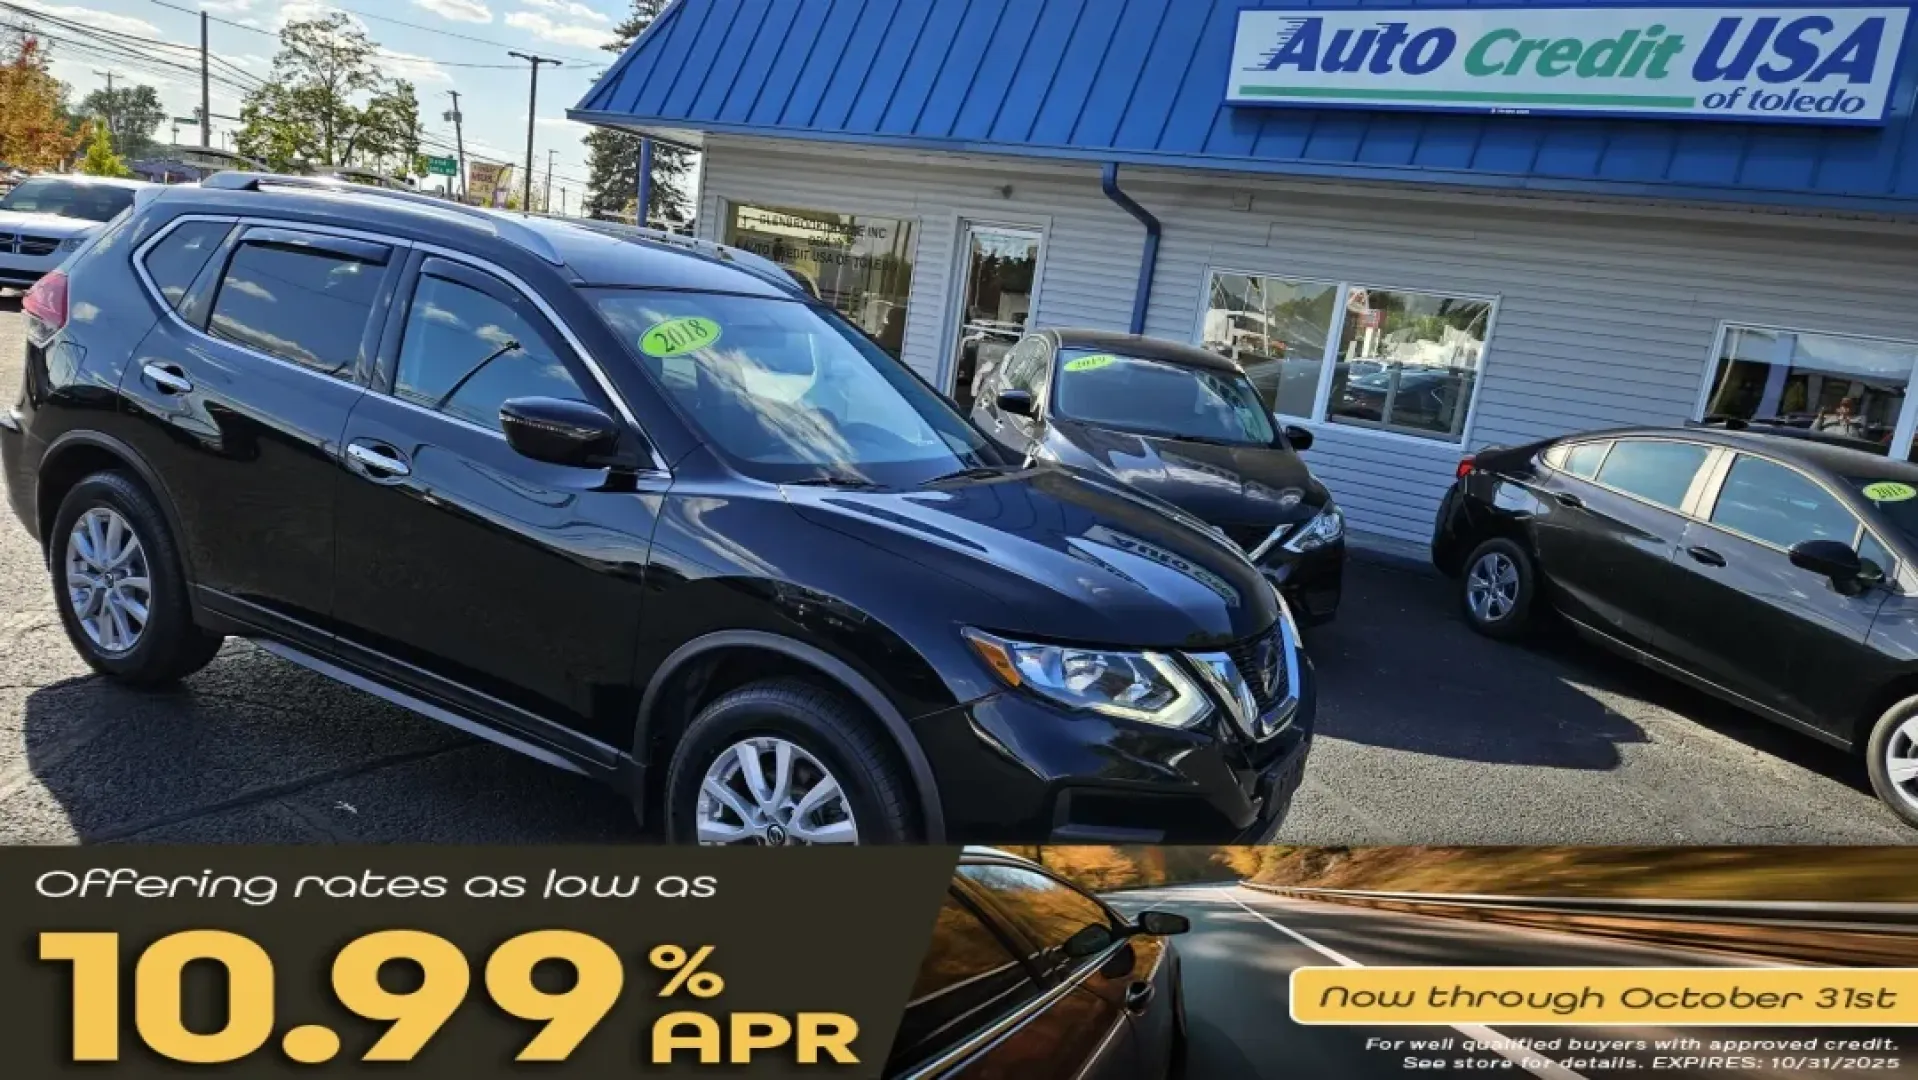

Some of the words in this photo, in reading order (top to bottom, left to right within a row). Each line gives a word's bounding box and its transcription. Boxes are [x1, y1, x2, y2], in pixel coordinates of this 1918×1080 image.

[1243, 16, 1457, 75] Auto
[1464, 24, 1685, 80] Credit
[1692, 15, 1887, 84] USA
[1703, 87, 1747, 110] of
[1747, 88, 1866, 114] toledo
[812, 250, 834, 264] USA
[653, 319, 708, 353] 2018
